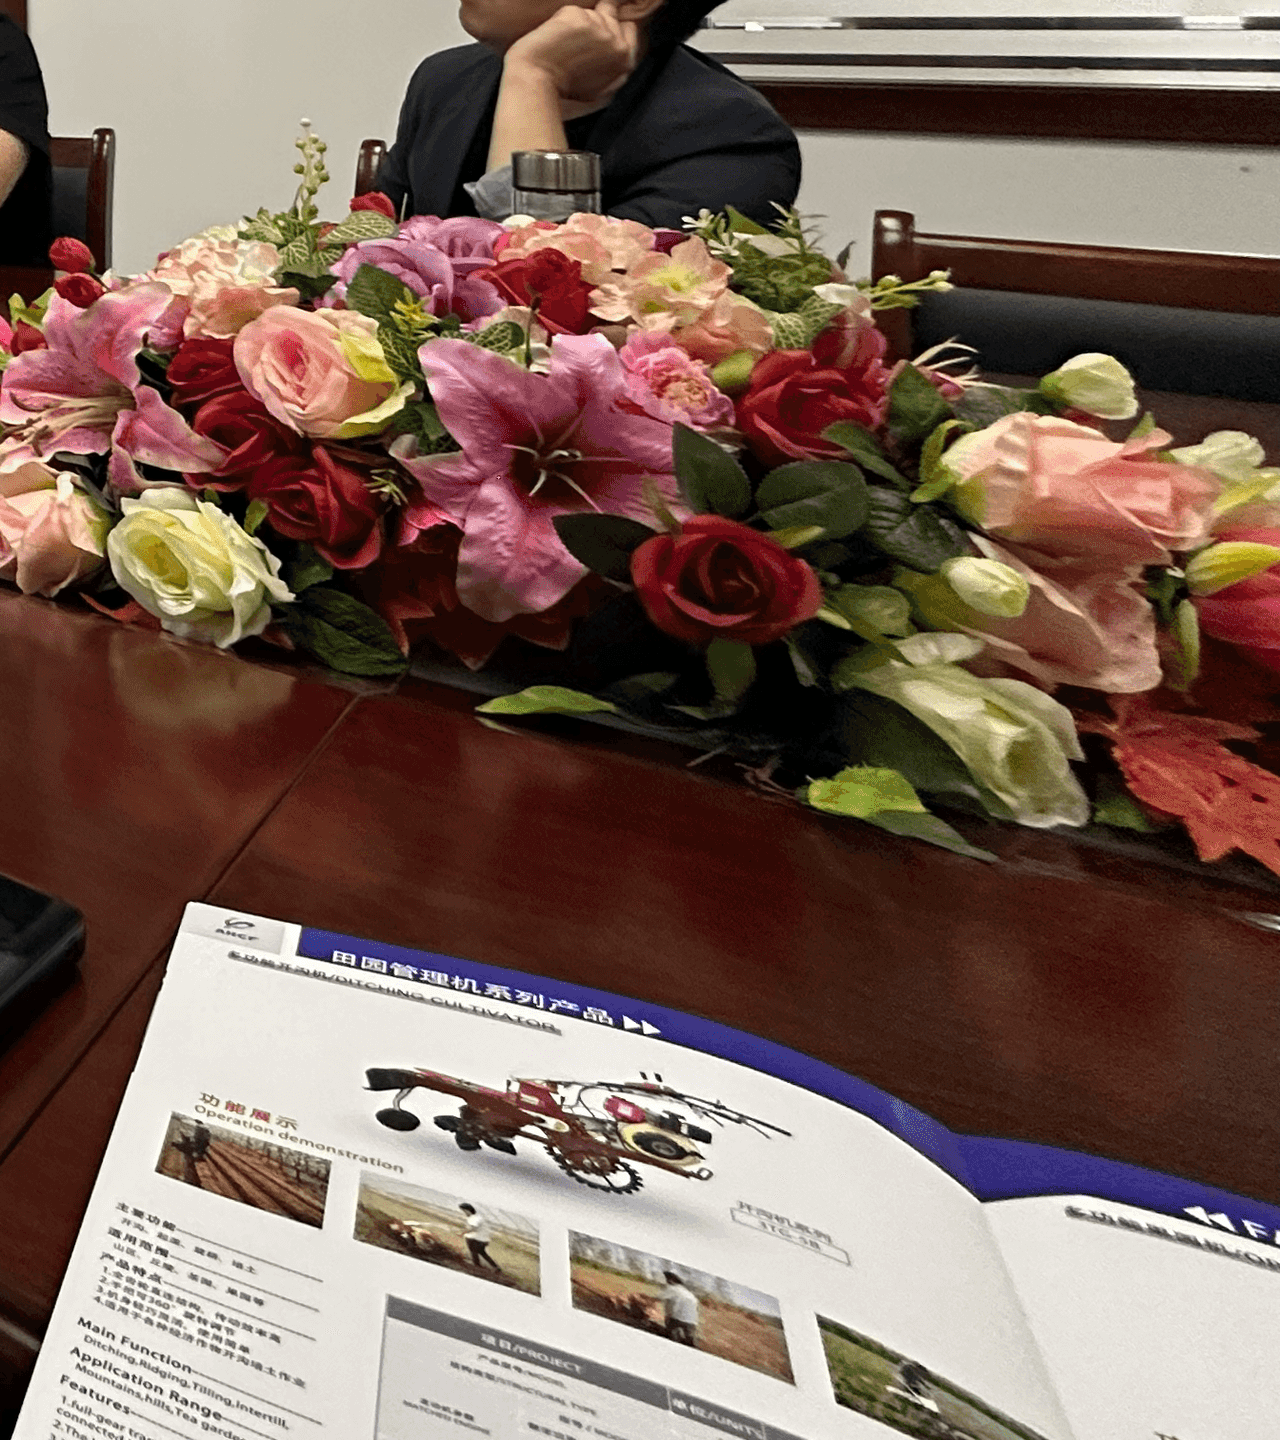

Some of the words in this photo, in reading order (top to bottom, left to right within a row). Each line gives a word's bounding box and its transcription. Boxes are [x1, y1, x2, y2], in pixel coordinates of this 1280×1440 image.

[332, 949, 614, 1026] 田园管理机系列产品
[430, 994, 560, 1034] CULTIVATOR
[199, 1092, 299, 1131] 功能展示
[194, 1104, 274, 1136] Operation
[278, 1130, 405, 1174] demonstration
[115, 1202, 176, 1232] 主要功能
[100, 1251, 162, 1285] 产品特点
[77, 1316, 116, 1341] Main
[120, 1336, 192, 1375] Function
[481, 1332, 584, 1374] 项目/PROJECT
[59, 1374, 131, 1415] Features
[69, 1346, 164, 1396] Application
[168, 1390, 223, 1422] Range
[201, 1420, 246, 1440] garde
